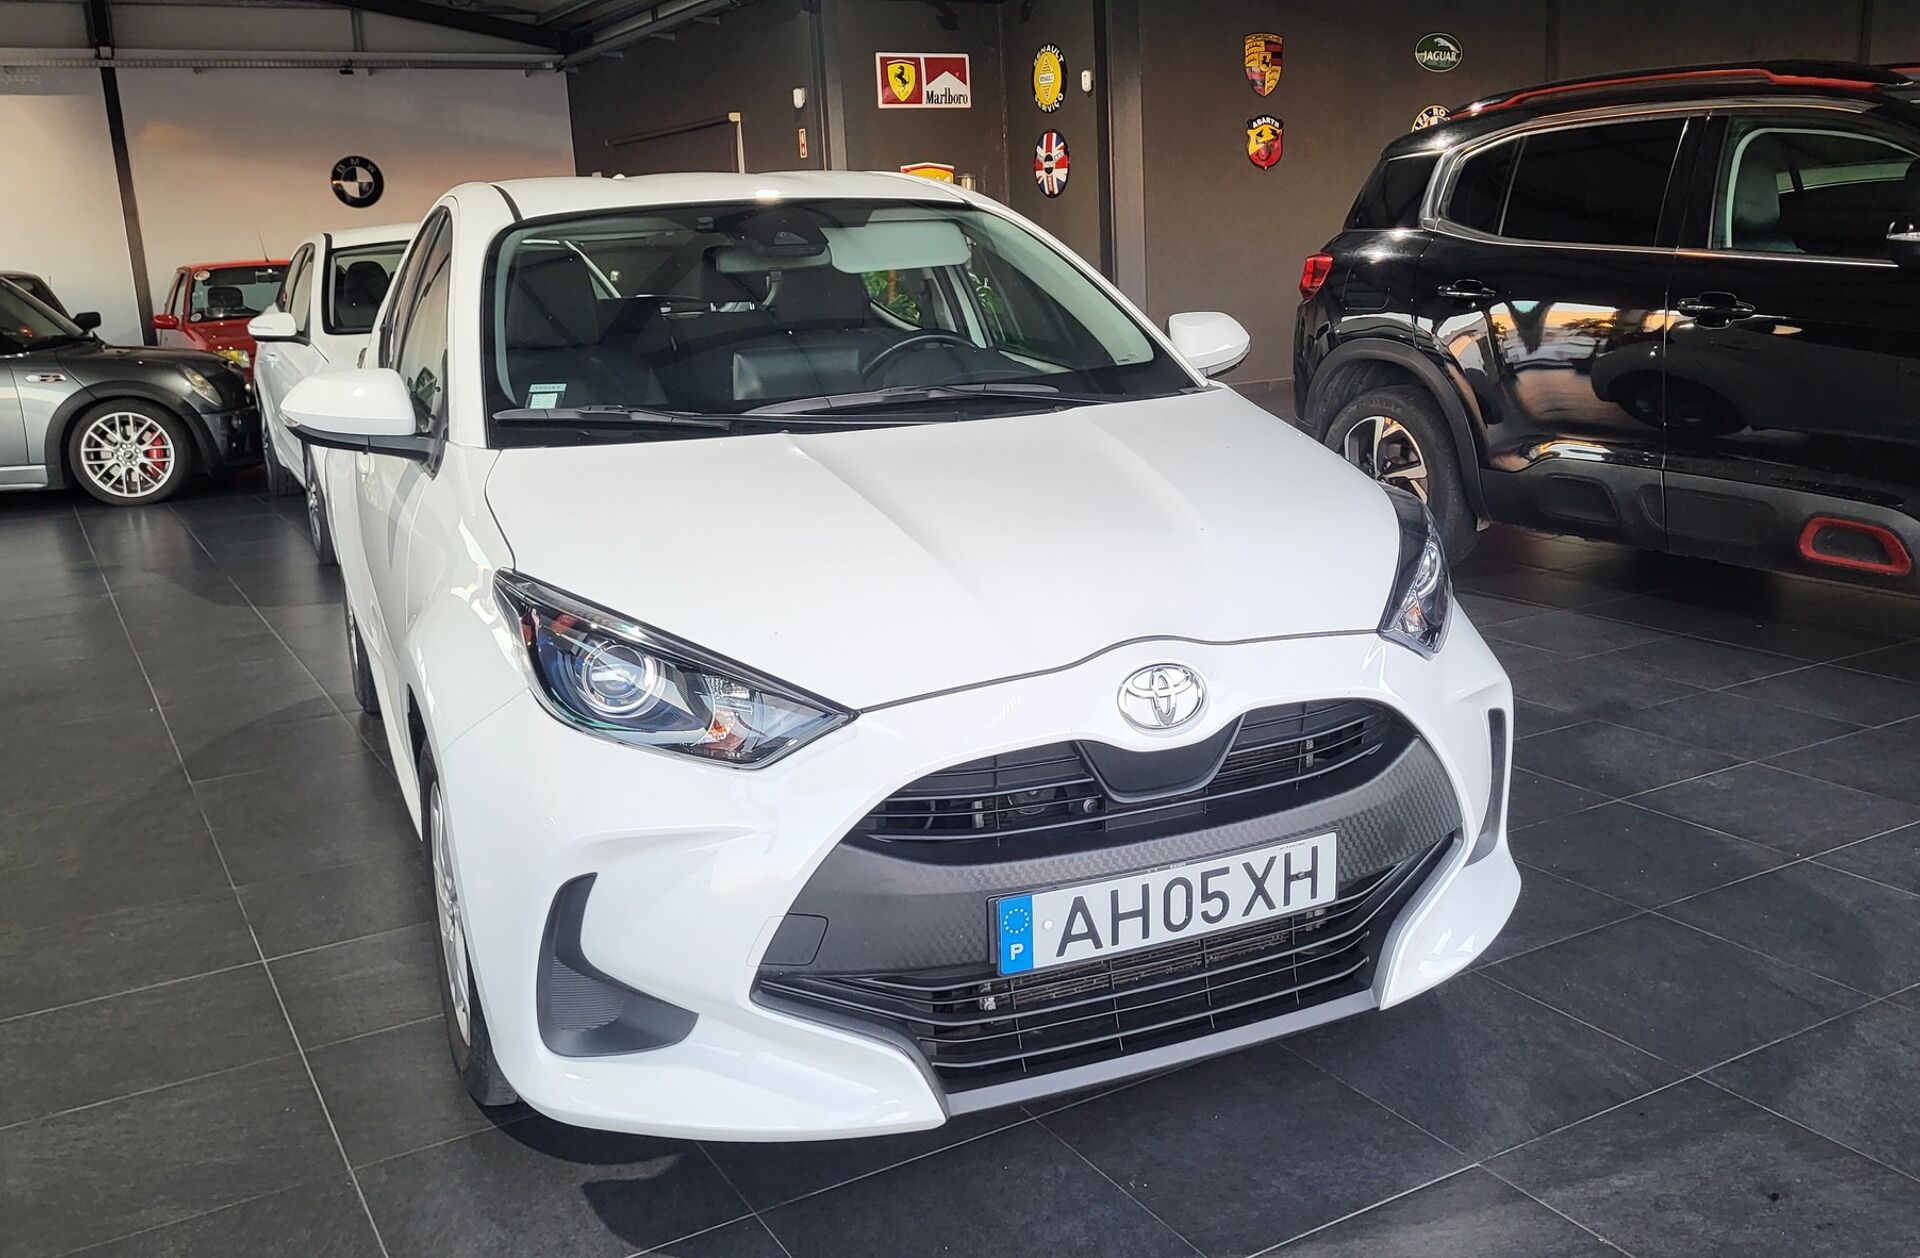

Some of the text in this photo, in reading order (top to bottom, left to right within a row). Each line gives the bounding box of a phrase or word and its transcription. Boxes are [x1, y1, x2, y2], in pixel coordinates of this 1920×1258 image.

[1422, 50, 1457, 62] JAGUAR
[926, 87, 968, 104] Marlboro
[1252, 117, 1280, 129] ABARTH
[336, 158, 376, 173] BMW
[1010, 943, 1024, 960] P
